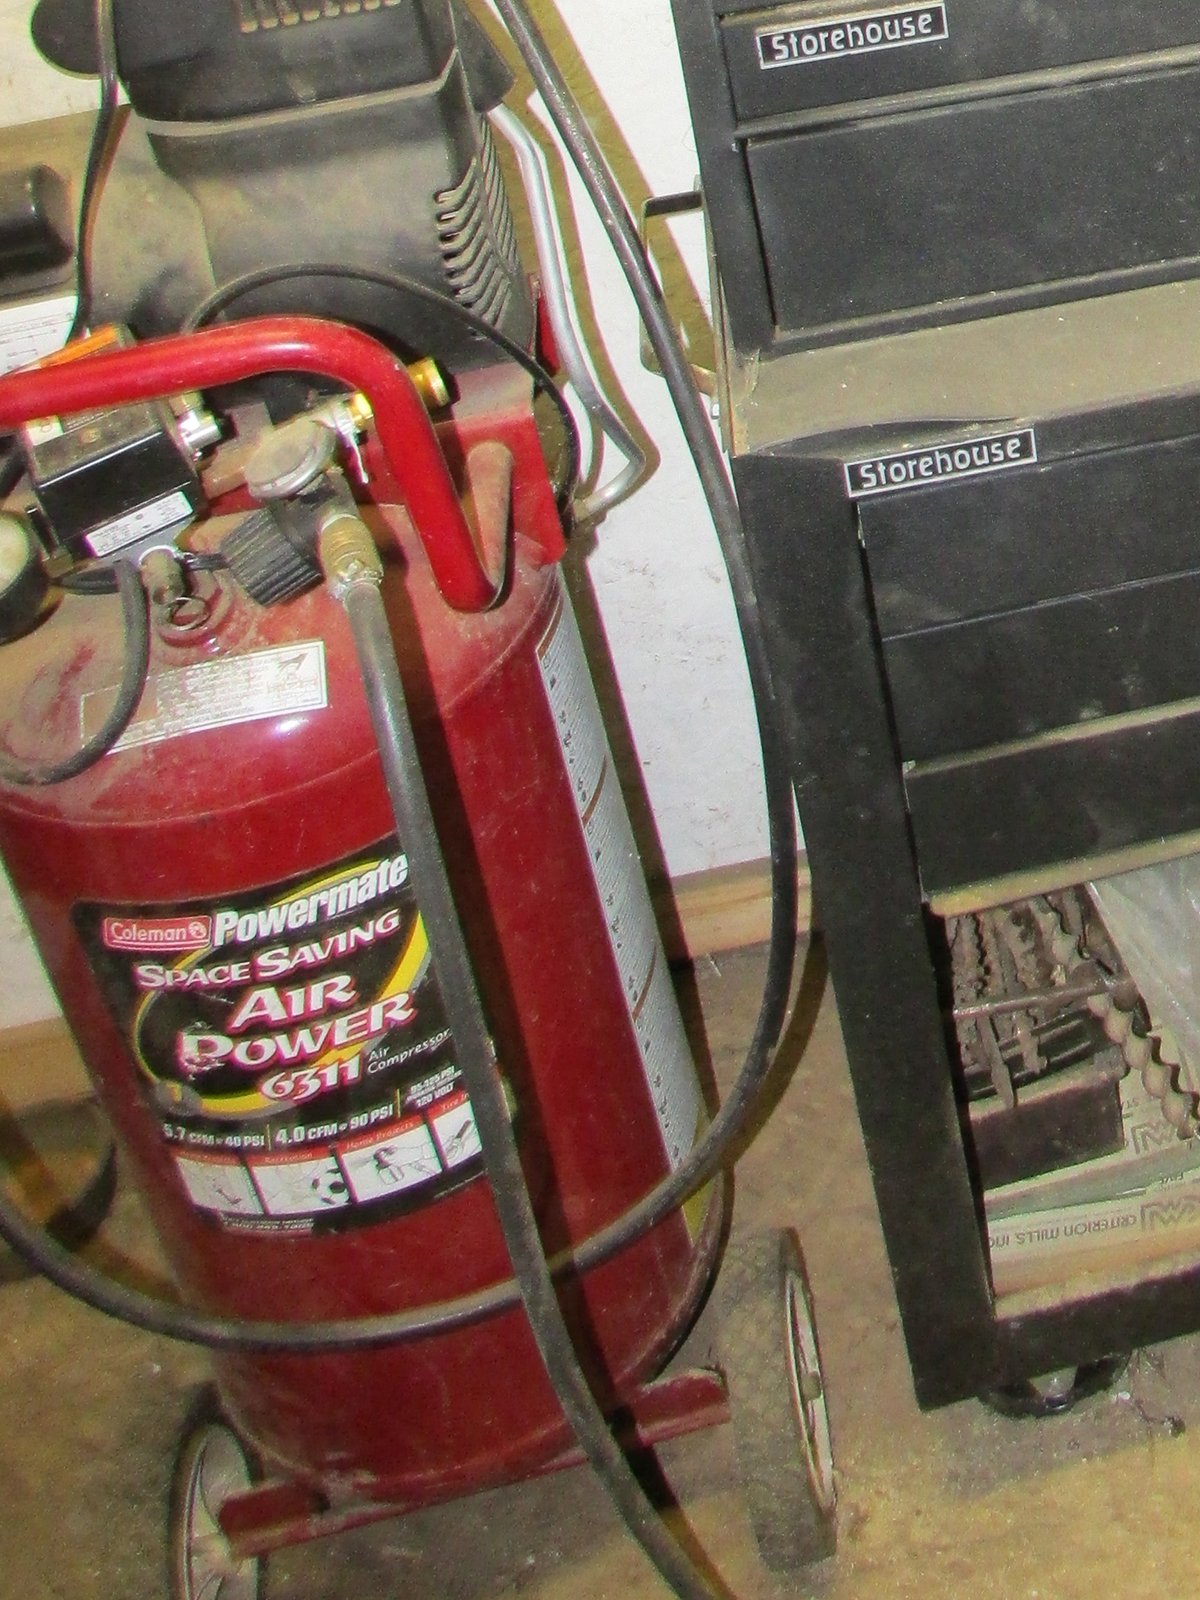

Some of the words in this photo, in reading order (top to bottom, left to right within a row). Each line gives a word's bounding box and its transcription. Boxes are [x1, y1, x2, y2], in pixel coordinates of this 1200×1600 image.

[771, 12, 932, 61] Storehouse
[860, 437, 1022, 488] Storehouse
[110, 921, 186, 942] Coleman
[213, 854, 409, 947] Powermate
[136, 962, 251, 989] SPACE
[256, 908, 400, 977] SAVING
[230, 974, 358, 1029] AIR
[181, 993, 415, 1071] POWER
[366, 1029, 451, 1075] Compressor
[368, 1045, 390, 1062] Air
[260, 1054, 361, 1100] 6311
[225, 1135, 242, 1147] 40
[243, 1134, 265, 1147] PSI
[275, 1125, 306, 1144] 4.0
[307, 1121, 338, 1140] CFM
[350, 1113, 369, 1130] 90
[370, 1103, 394, 1123] PSI
[1064, 1214, 1137, 1238] CRITERION
